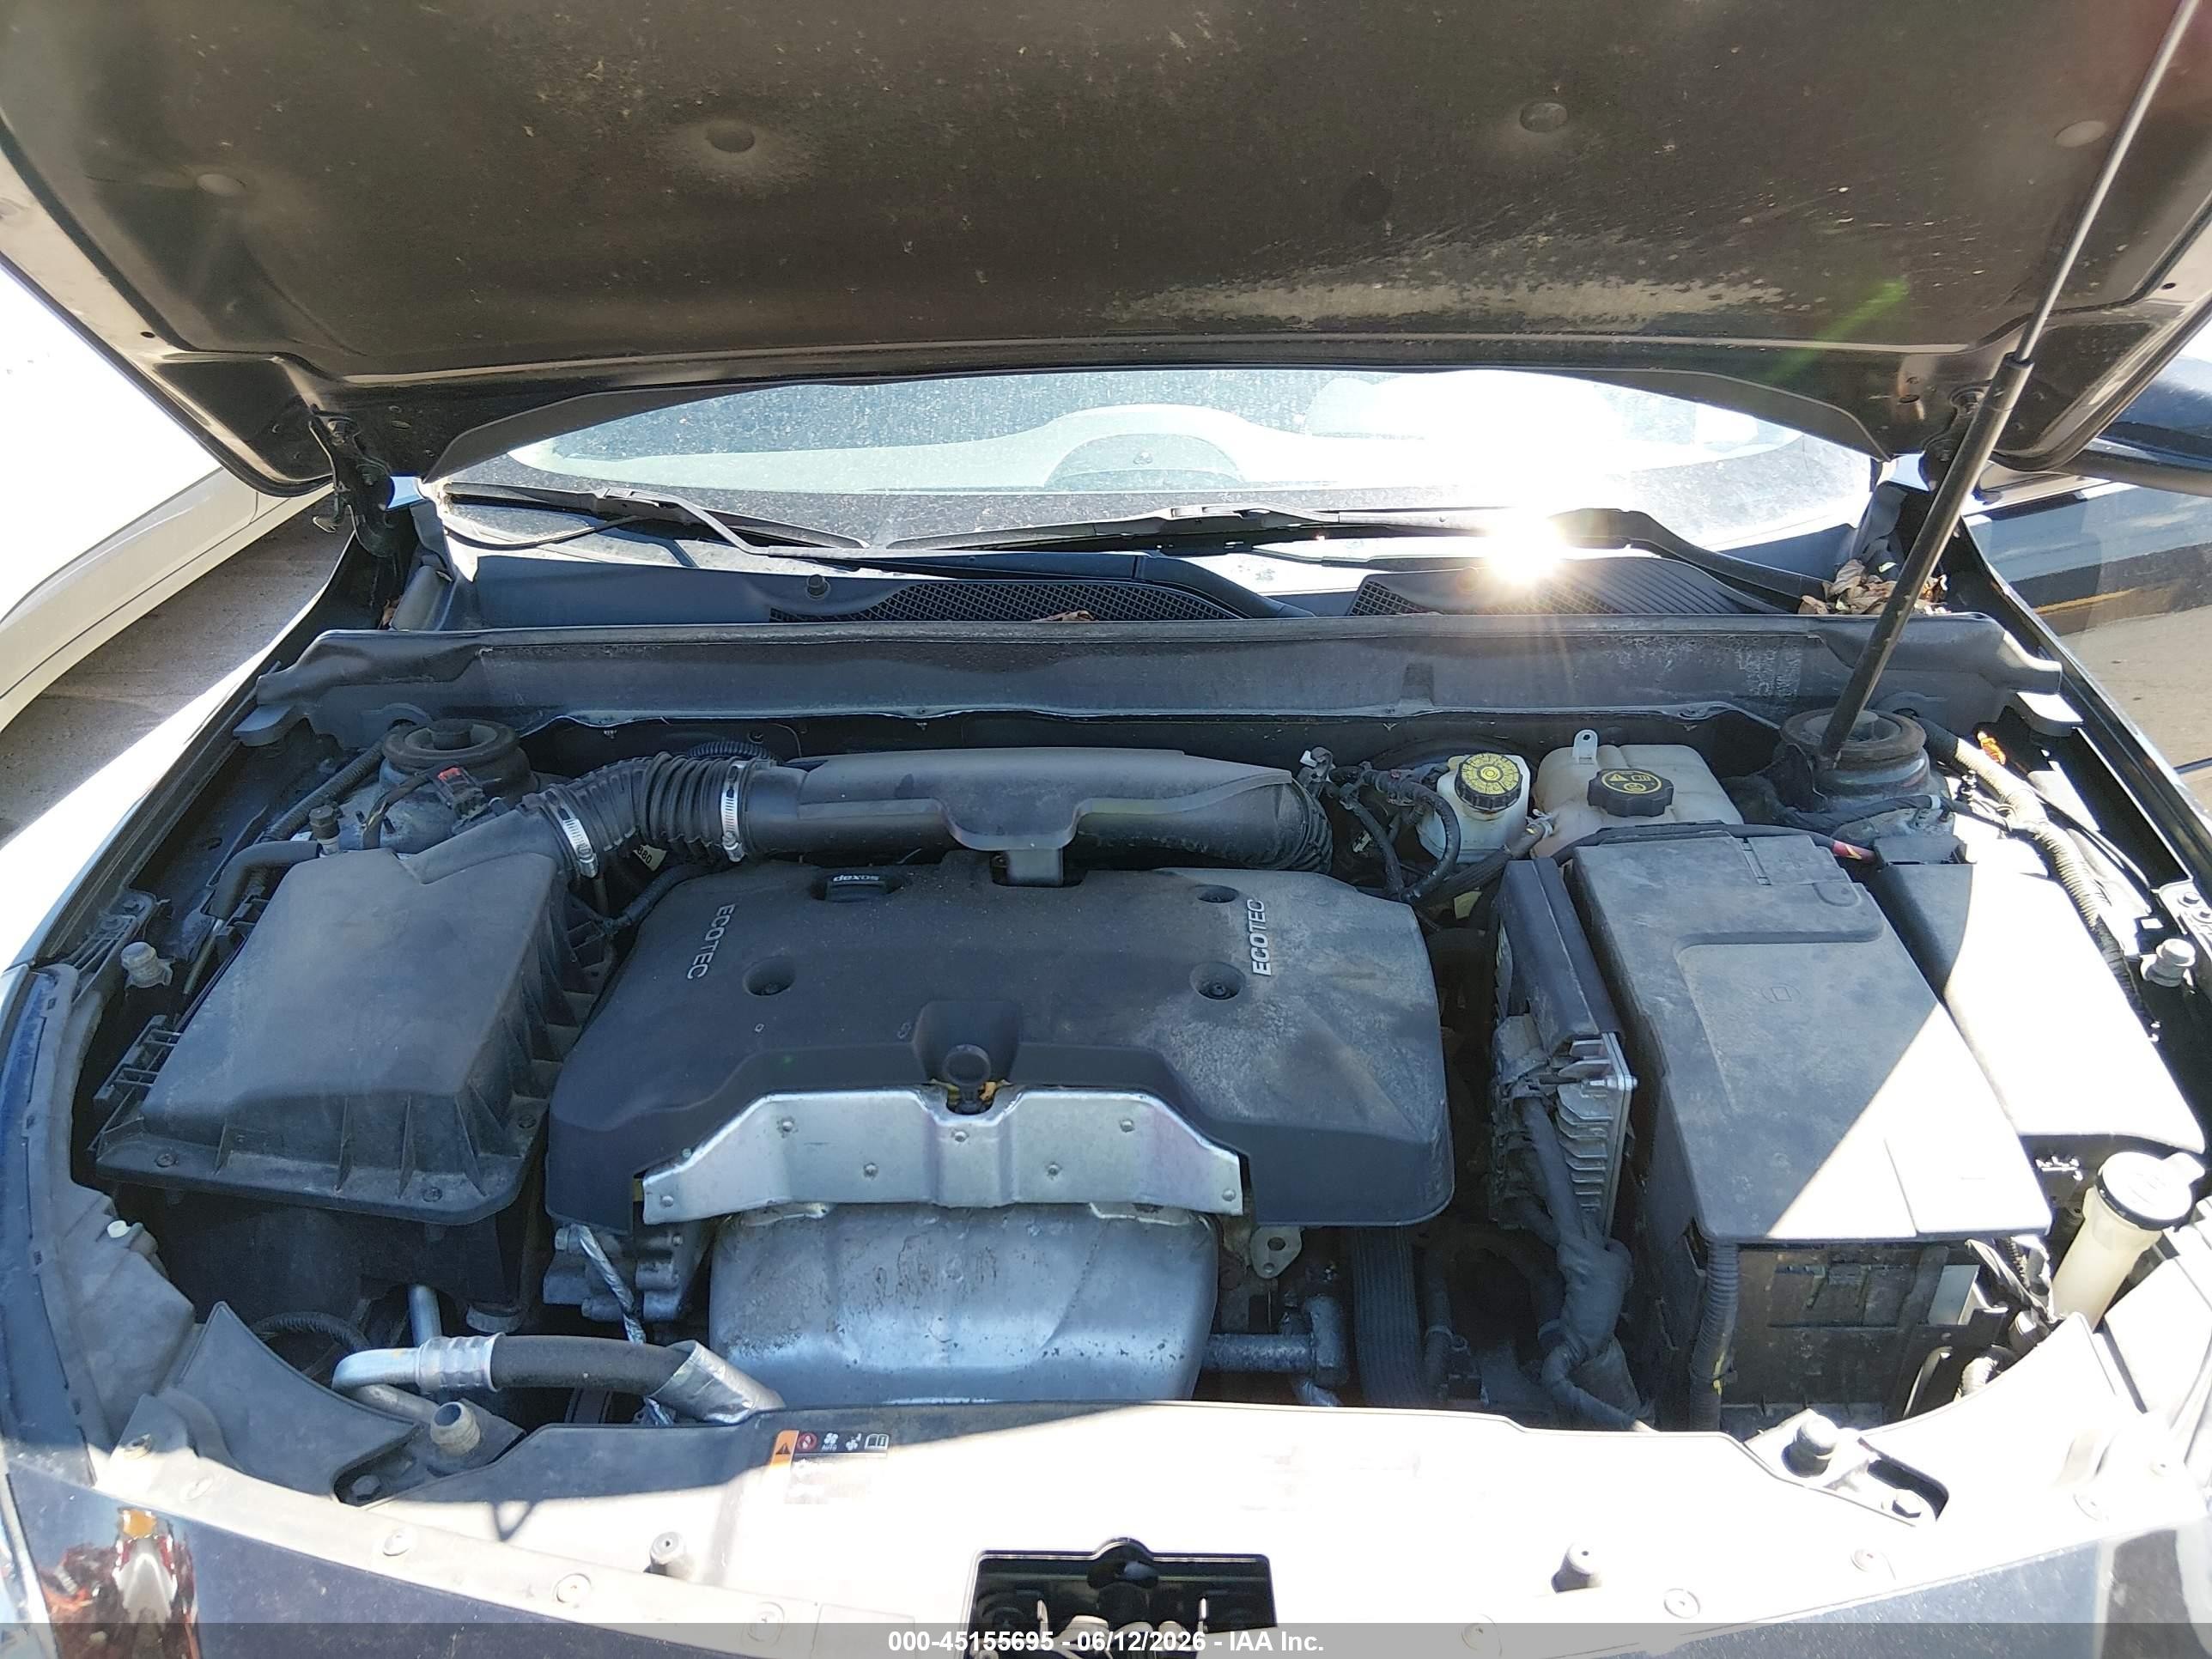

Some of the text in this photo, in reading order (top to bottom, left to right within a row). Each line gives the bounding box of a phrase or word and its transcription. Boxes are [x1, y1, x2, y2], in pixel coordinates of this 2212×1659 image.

[832, 872, 880, 883] dexos
[686, 903, 736, 980] ECOTEC
[1246, 898, 1272, 976] ECOTEC
